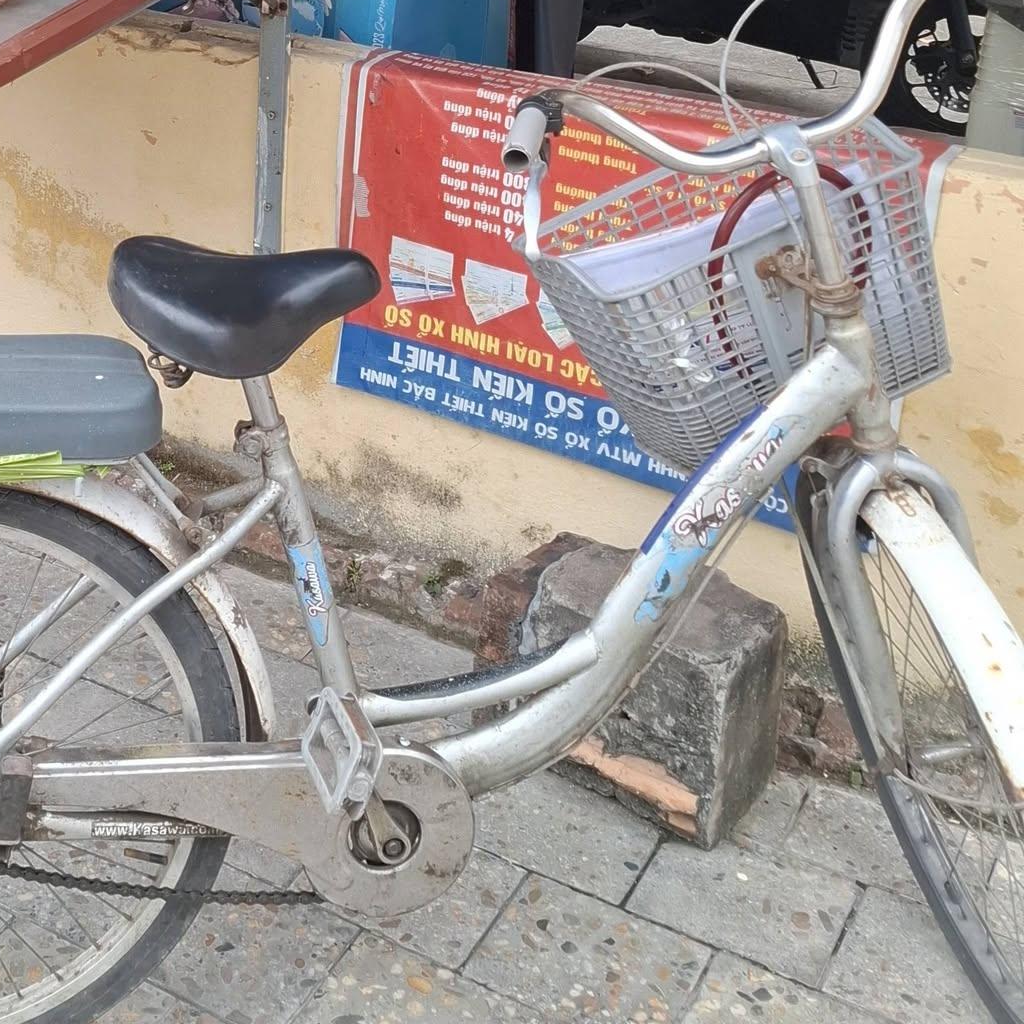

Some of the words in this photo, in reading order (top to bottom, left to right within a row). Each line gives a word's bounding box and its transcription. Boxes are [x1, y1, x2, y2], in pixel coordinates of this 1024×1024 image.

[476, 88, 505, 104] đồng
[443, 100, 472, 118] đồng
[475, 107, 502, 124] triệu
[450, 121, 480, 139] đồng
[441, 156, 469, 174] đồng
[558, 145, 600, 166] thưởng
[472, 164, 500, 181] triệu
[604, 156, 638, 175] Trúng
[440, 174, 468, 191] đồng
[471, 182, 498, 199] triệu
[443, 192, 471, 209] đồng
[501, 190, 527, 207] 00
[444, 210, 471, 227] đồng
[473, 200, 501, 218] triệu
[474, 219, 502, 236] triệu
[504, 228, 515, 243] 4
[384, 305, 413, 328] SỐ
[417, 314, 445, 338] XỔ
[451, 324, 500, 356] HÌNH
[388, 341, 461, 382] THIẾT
[506, 341, 553, 370] LOẠI
[360, 366, 398, 389] NINH
[472, 365, 534, 406] KIẾN
[402, 380, 437, 402] BẮC
[441, 392, 485, 417] THIẾT
[544, 390, 585, 420] SỐ
[491, 407, 528, 432] KIẾN
[534, 421, 559, 440] SỐ
[564, 432, 591, 450] XỔ
[596, 442, 642, 468] MTV
[648, 458, 689, 483] NHH
